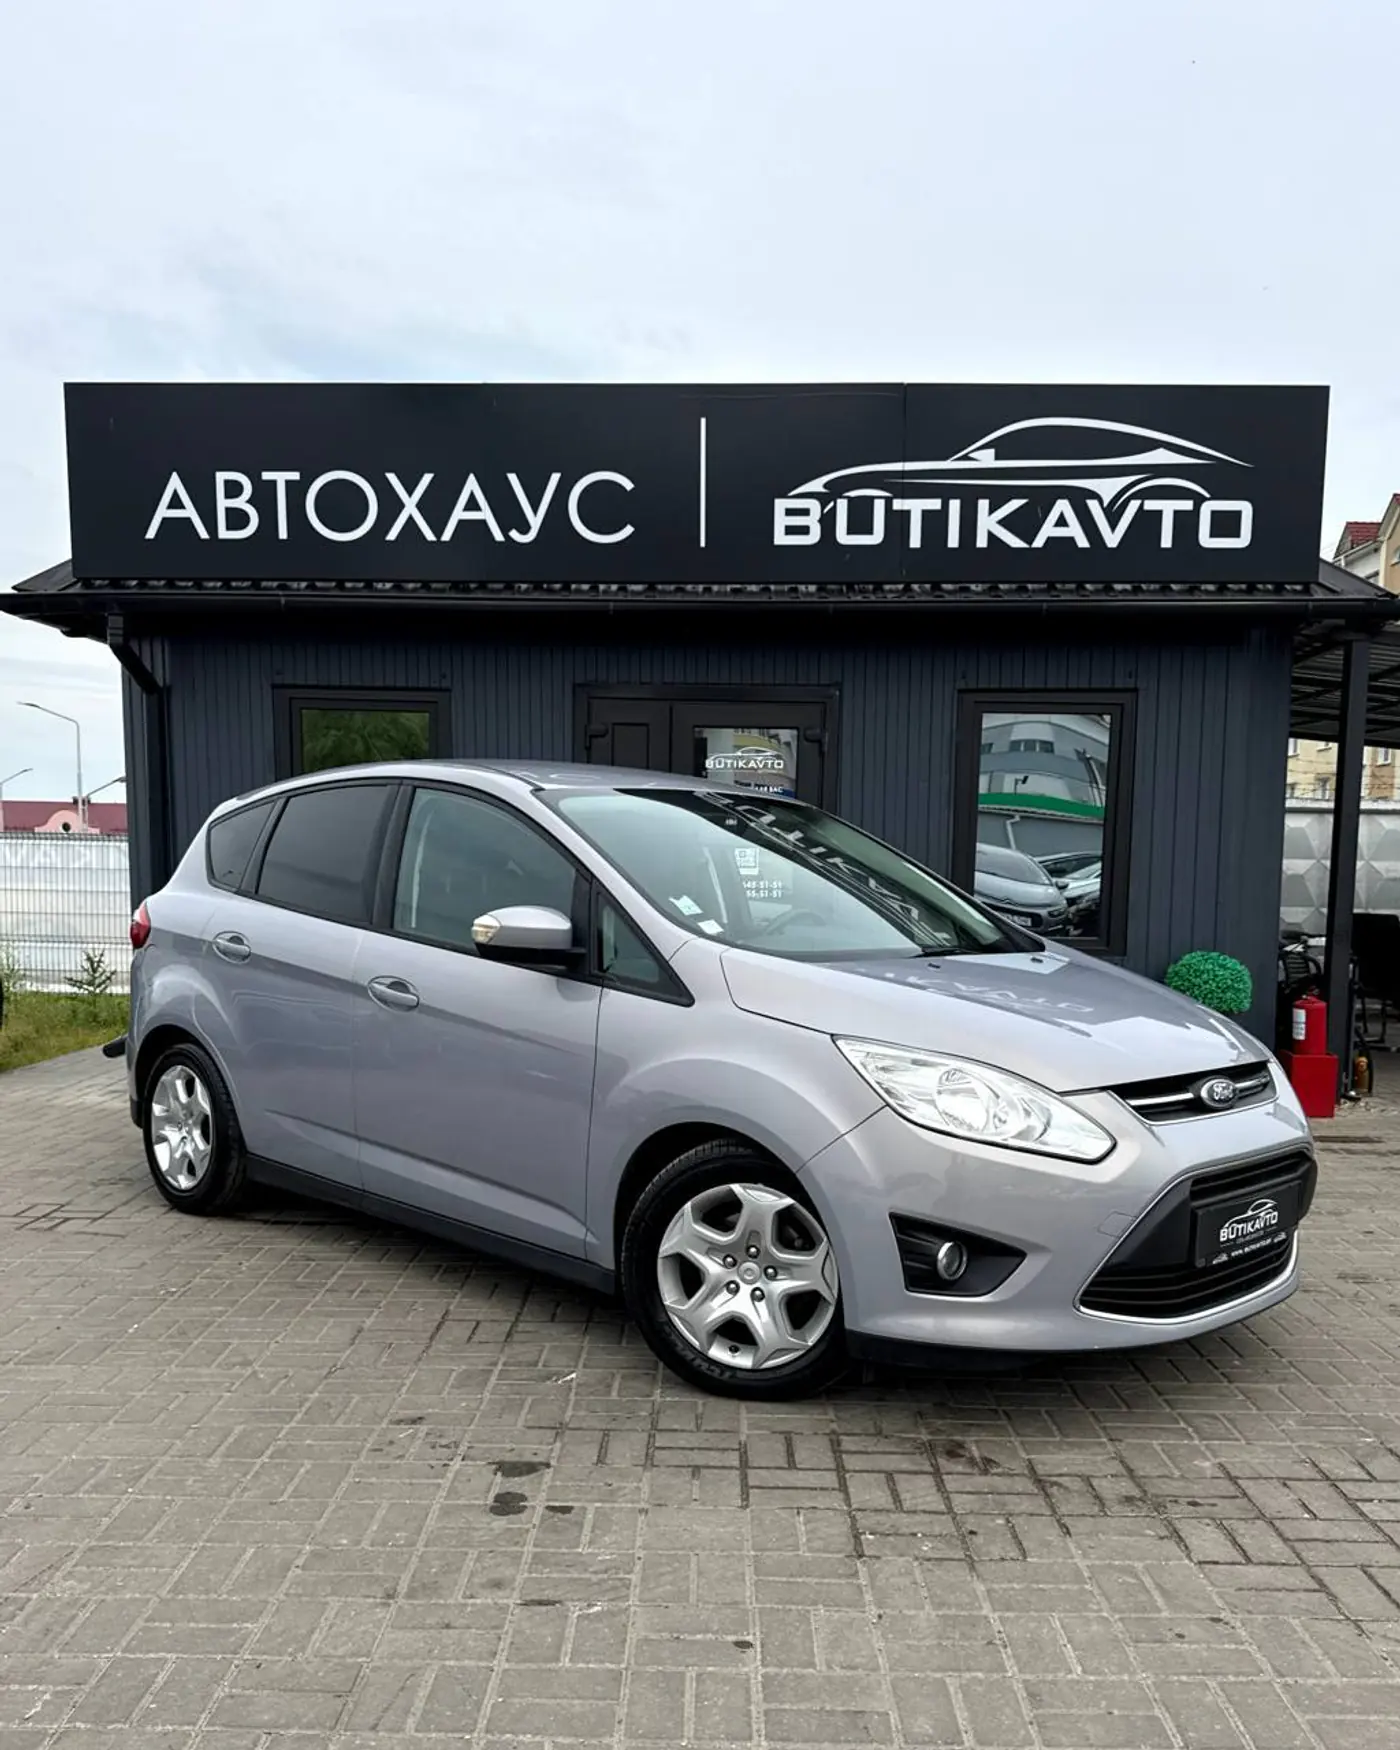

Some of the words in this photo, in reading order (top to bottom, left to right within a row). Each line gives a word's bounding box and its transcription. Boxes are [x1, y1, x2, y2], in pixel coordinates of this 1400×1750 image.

[144, 470, 636, 544] АВТОХАУС
[773, 497, 1254, 549] BUTIKAVTO
[705, 757, 785, 769] BUTIKAVTO
[1219, 1211, 1279, 1242] BUTIKAVTO
